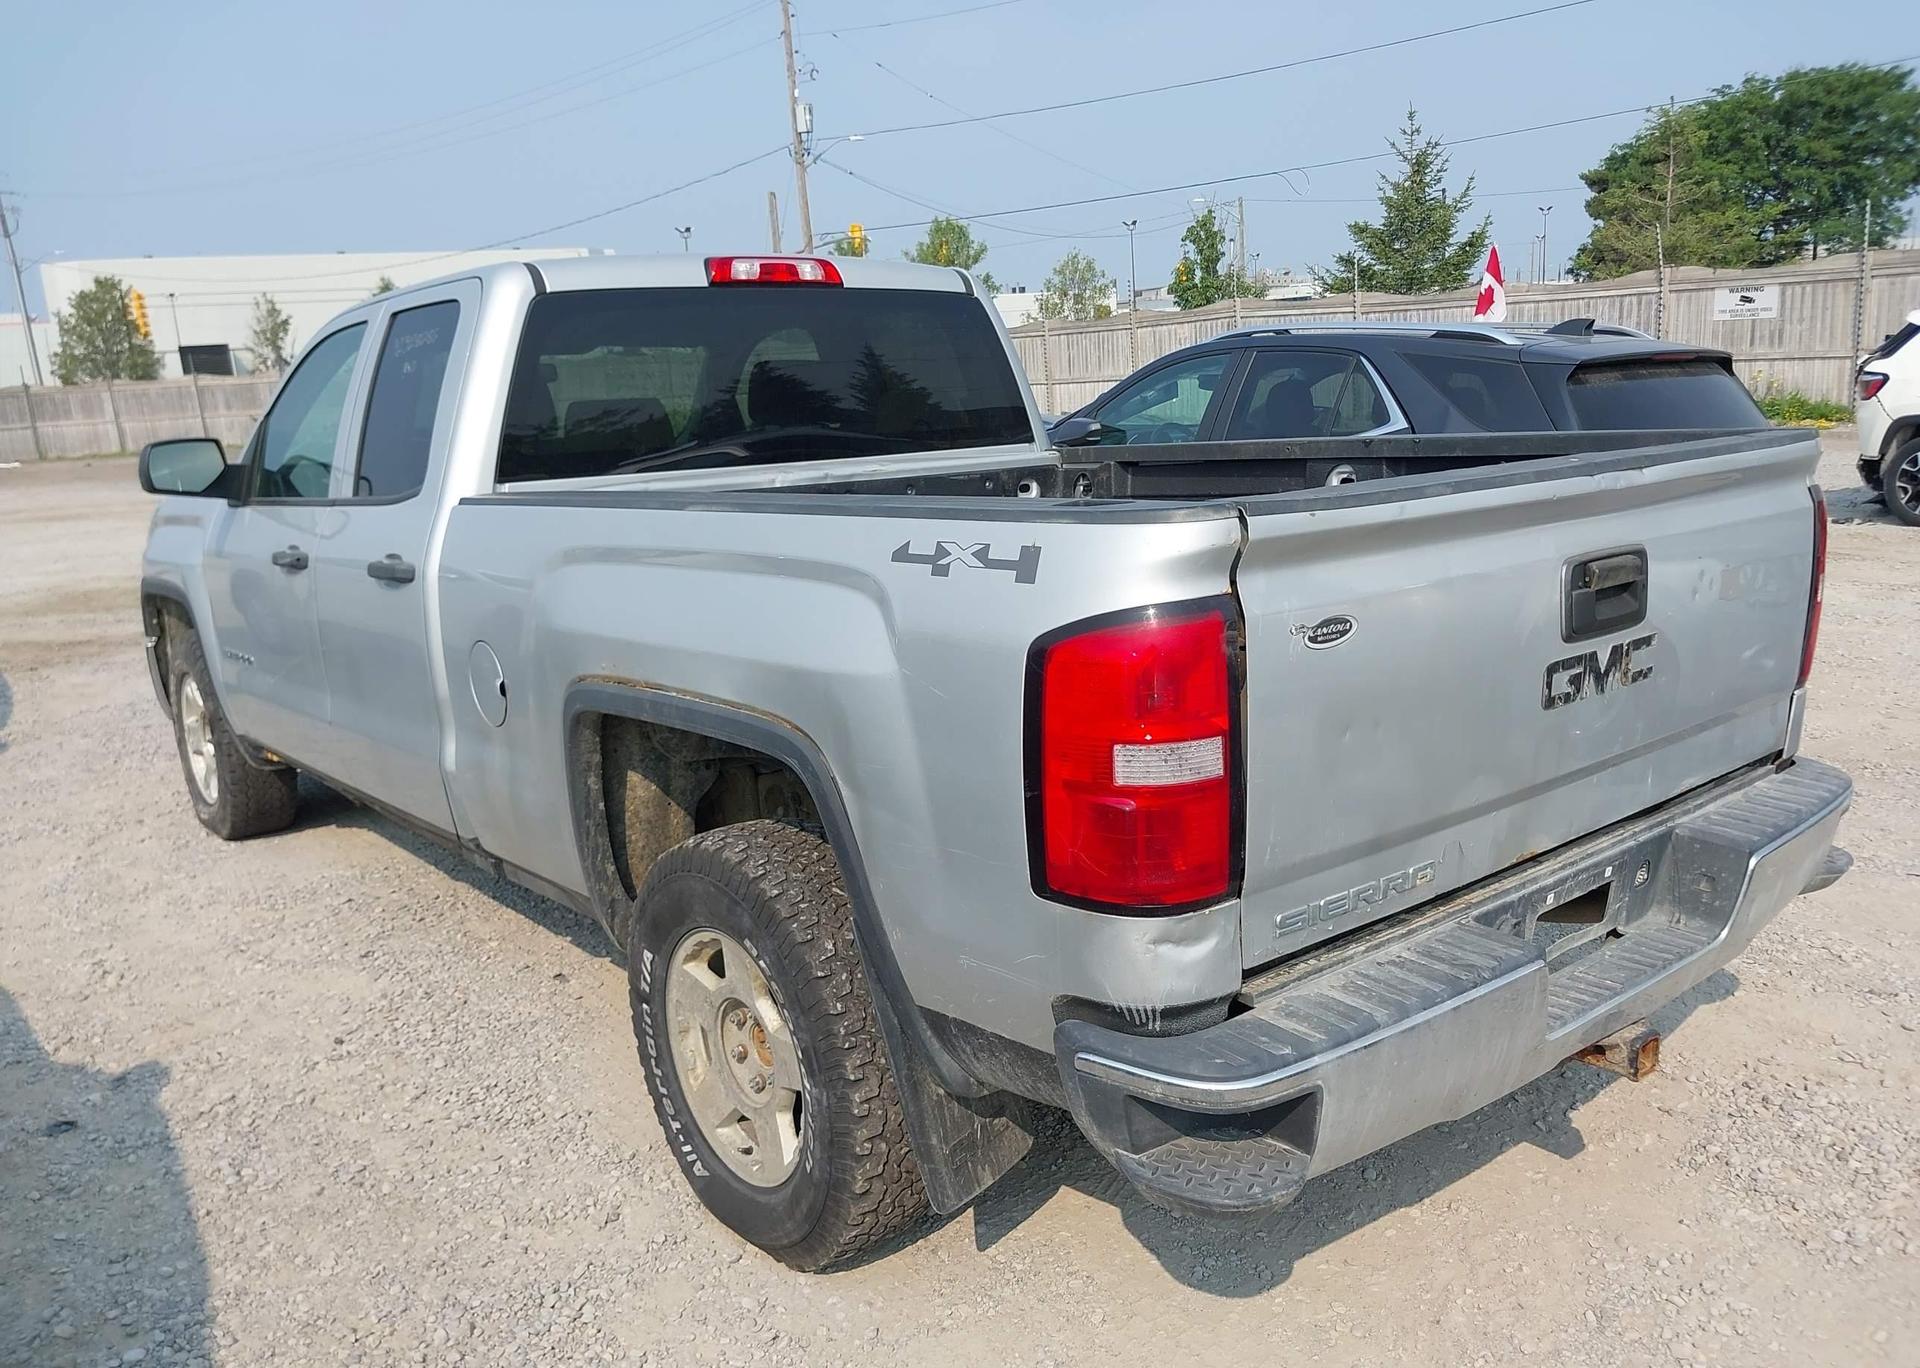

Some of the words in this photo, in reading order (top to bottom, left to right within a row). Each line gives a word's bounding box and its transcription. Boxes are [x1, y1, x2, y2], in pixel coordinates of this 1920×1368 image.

[1728, 286, 1765, 294] WARNING
[1541, 633, 1657, 711] GMC
[1274, 860, 1436, 939] SIERRA
[640, 948, 654, 994] T/A
[641, 1002, 711, 1177] All-Terrain
